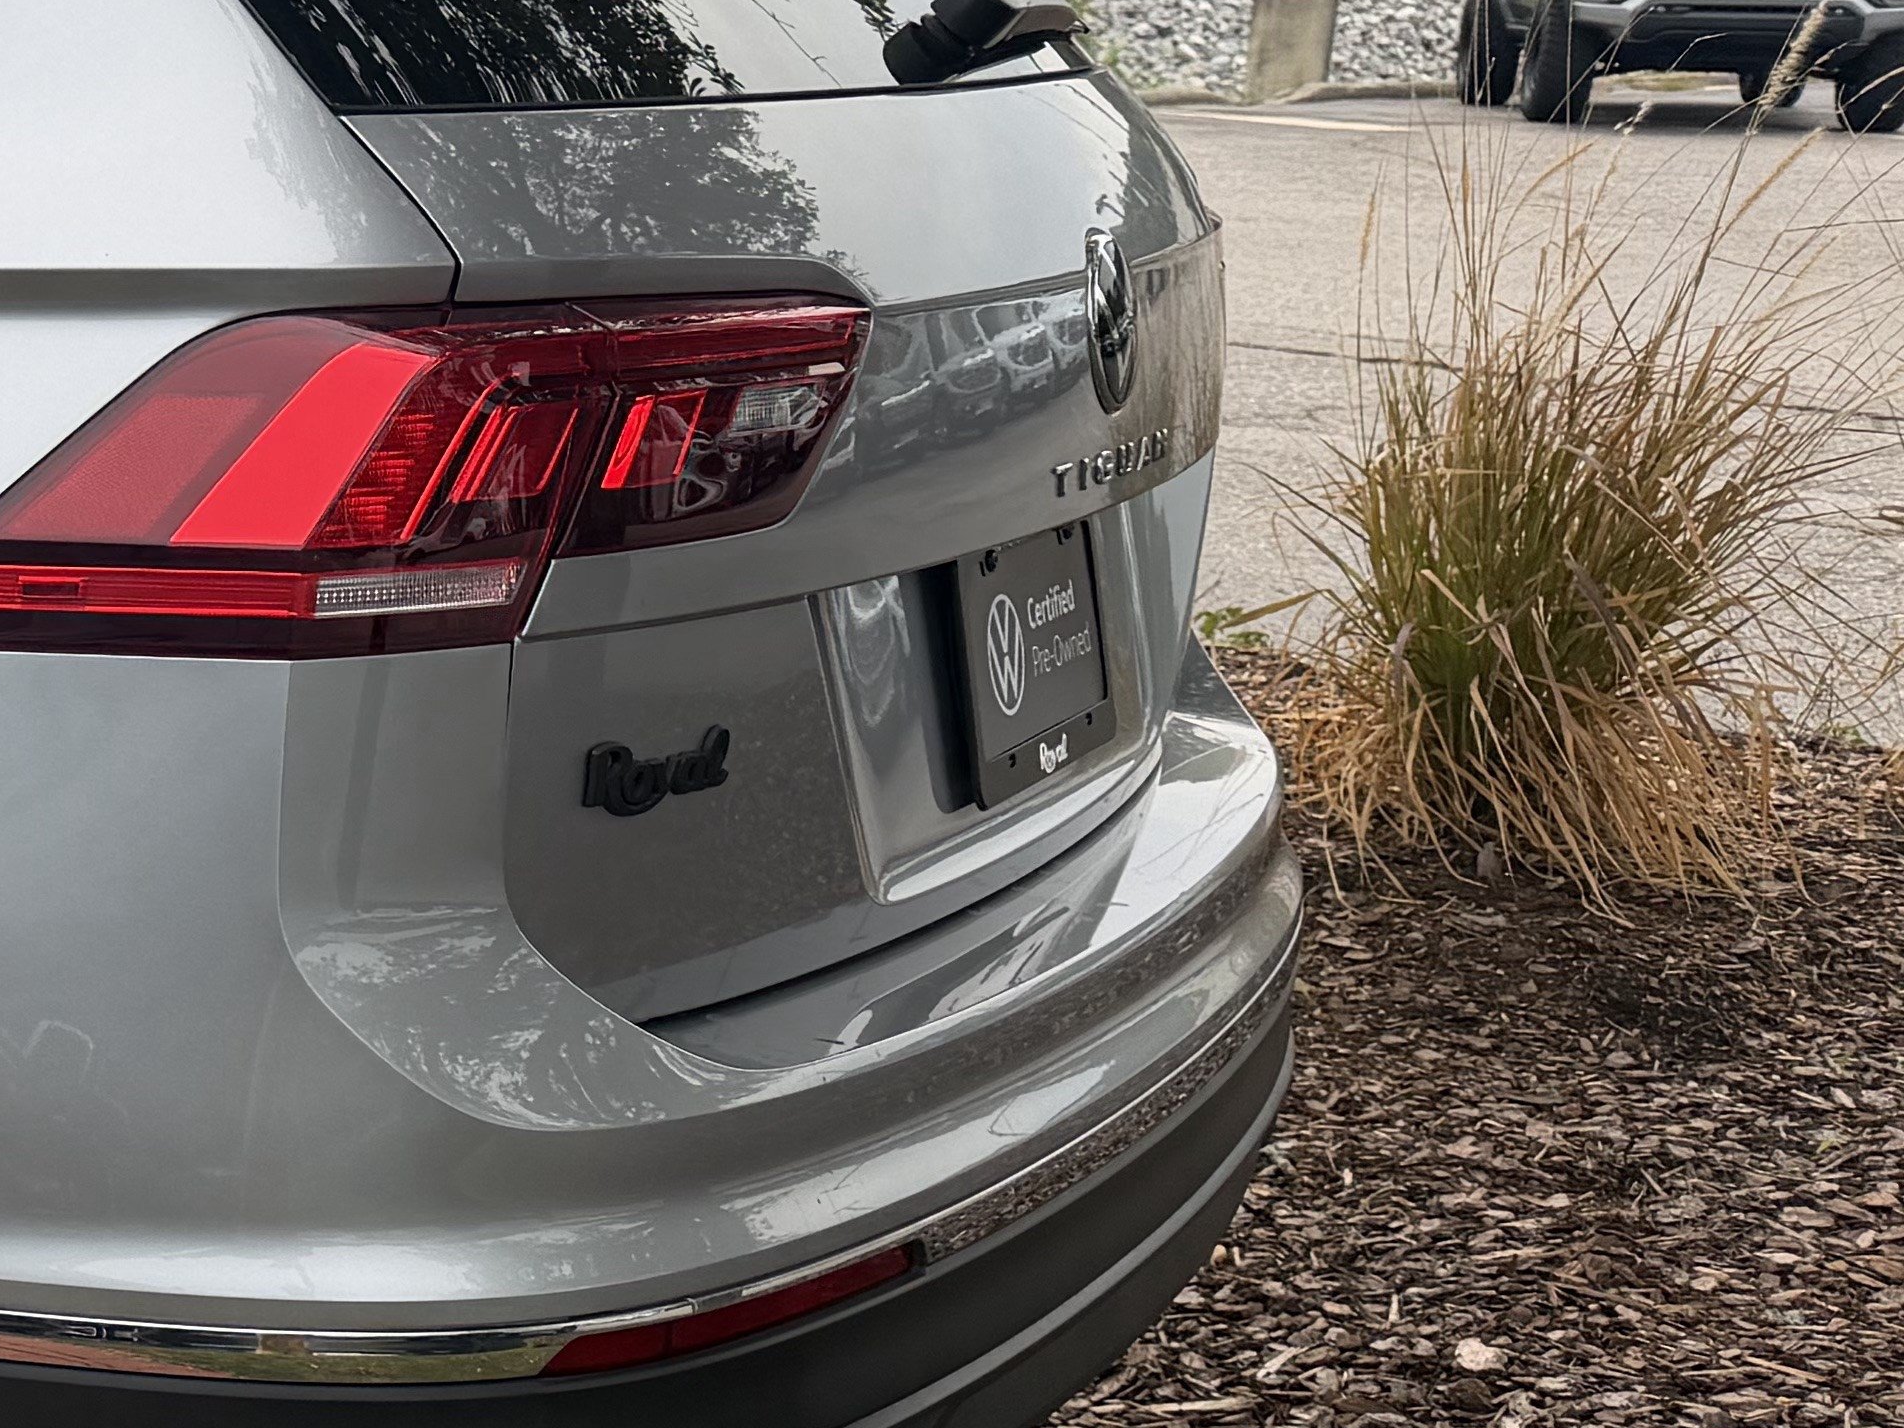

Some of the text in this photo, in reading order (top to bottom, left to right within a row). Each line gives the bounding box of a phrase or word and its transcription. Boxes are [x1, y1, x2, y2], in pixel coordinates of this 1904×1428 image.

[1027, 578, 1076, 630] Certified
[1032, 620, 1092, 678] Pre-Owned
[581, 724, 731, 818] Royal
